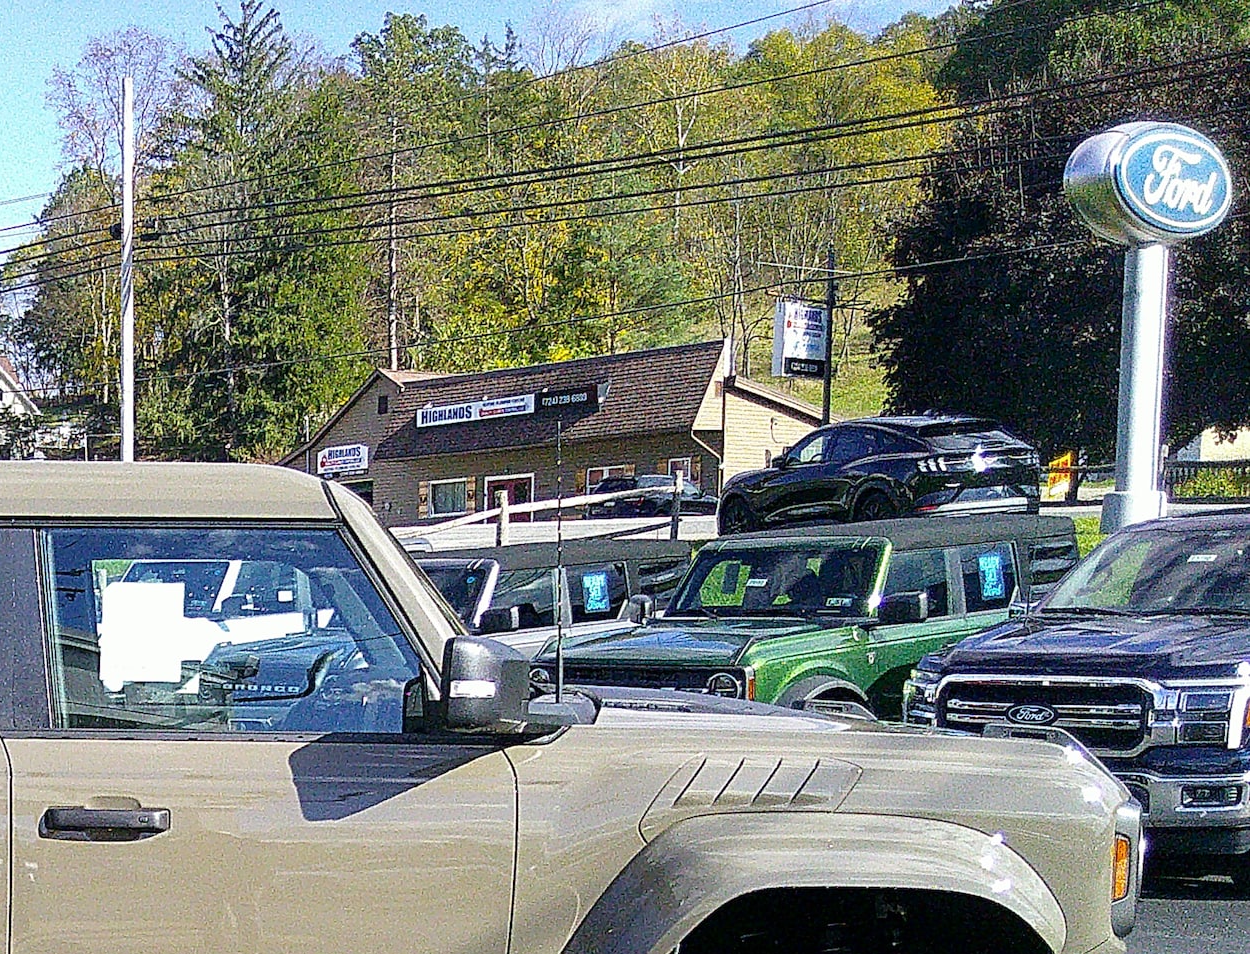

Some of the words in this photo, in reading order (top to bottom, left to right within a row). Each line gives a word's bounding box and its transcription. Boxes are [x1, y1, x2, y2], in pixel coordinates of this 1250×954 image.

[1143, 144, 1218, 215] Ford
[421, 405, 473, 425] HIGHLANDS
[1016, 706, 1045, 721] Ford
